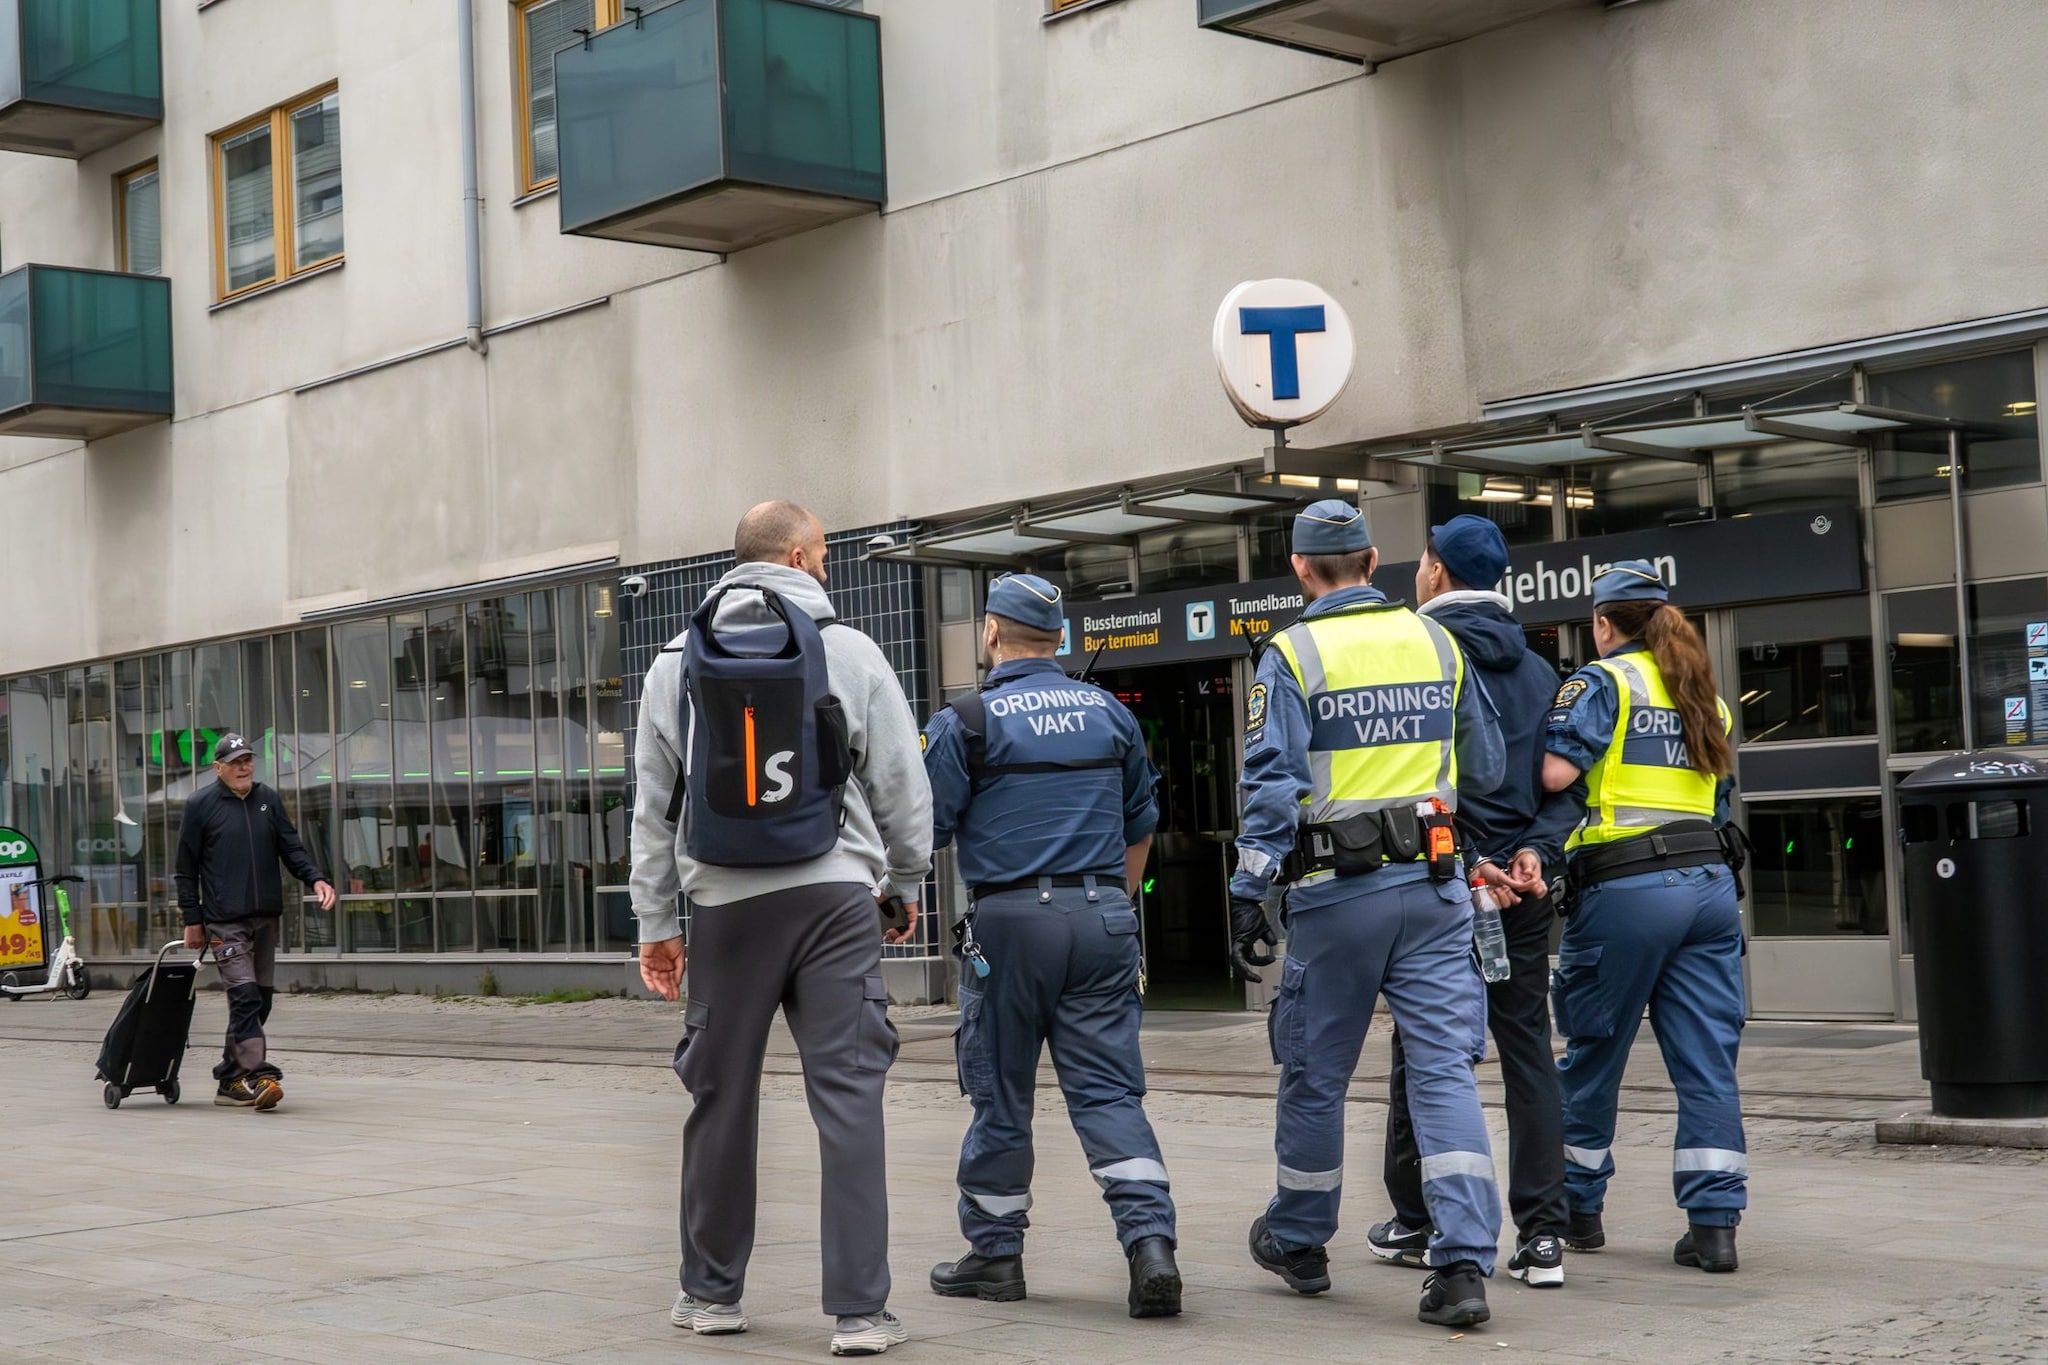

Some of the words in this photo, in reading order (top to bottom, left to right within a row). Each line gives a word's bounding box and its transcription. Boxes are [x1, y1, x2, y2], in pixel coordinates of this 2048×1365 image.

[1239, 304, 1326, 400] T
[1495, 554, 1677, 605] jeholn
[1229, 593, 1304, 616] Tunnelbana
[1083, 608, 1161, 633] Bussterminal
[1193, 611, 1208, 633] T
[1108, 628, 1159, 650] terminal
[989, 689, 1107, 717] ORDNINGS
[1317, 685, 1452, 720] ORDNINGS
[1027, 711, 1086, 736] VAKT
[1354, 714, 1425, 744] VAKT
[1664, 740, 1691, 768] VA
[760, 750, 795, 803] S
